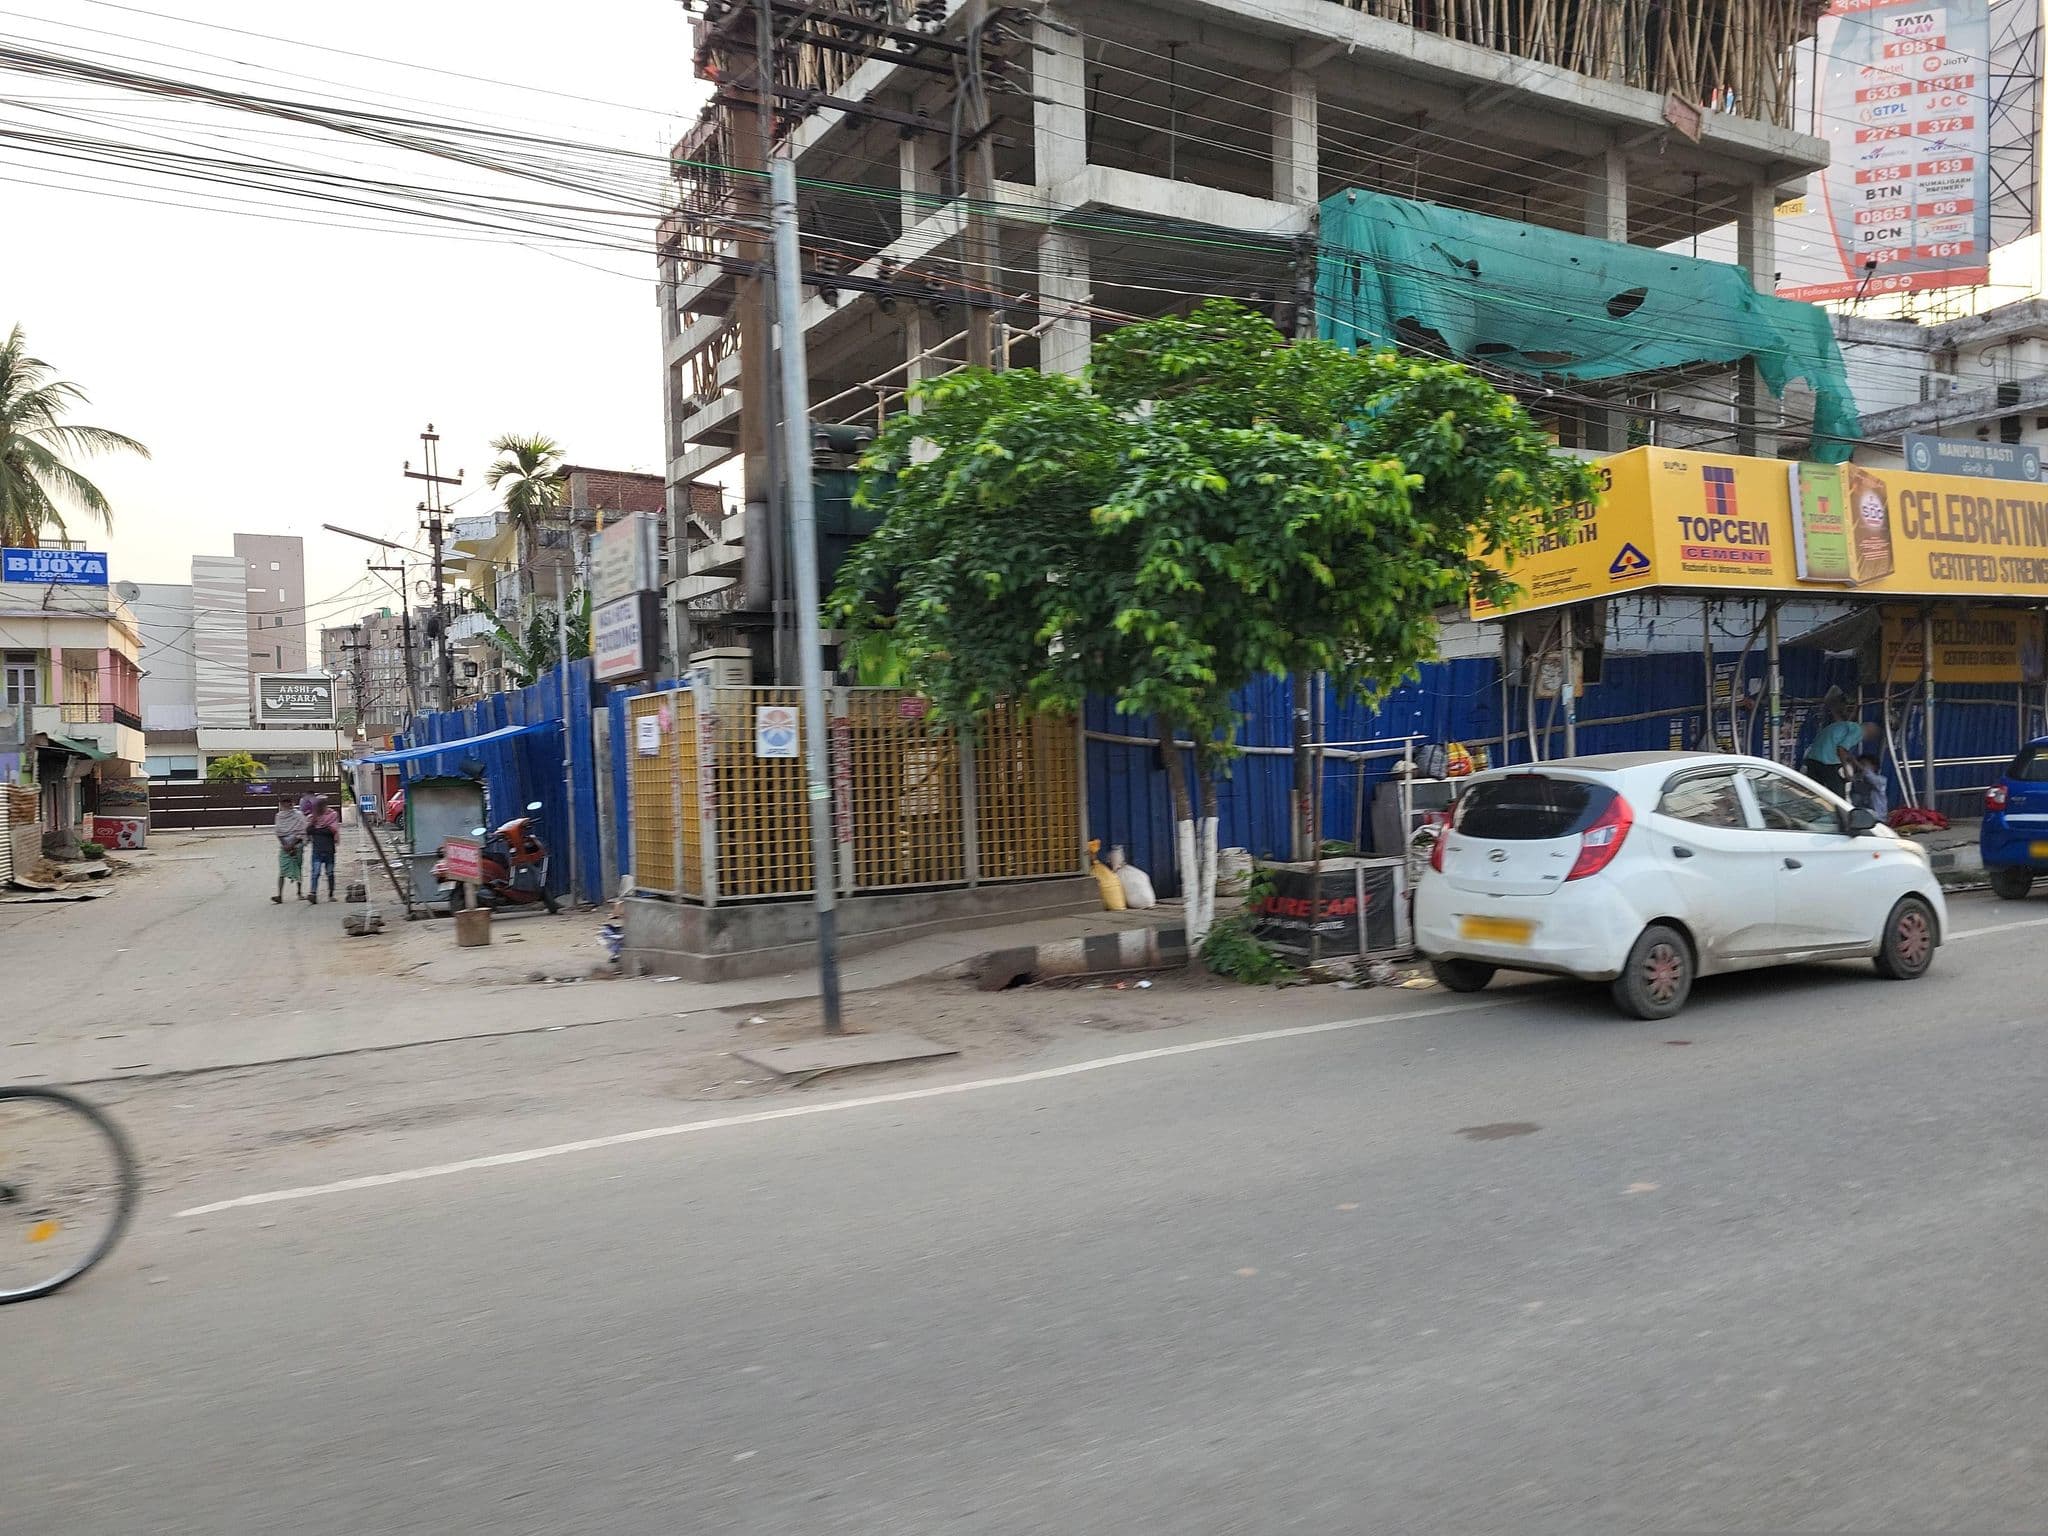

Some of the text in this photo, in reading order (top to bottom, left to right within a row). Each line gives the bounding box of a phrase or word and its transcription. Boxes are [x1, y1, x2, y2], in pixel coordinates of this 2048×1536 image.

[1894, 14, 1934, 28] TATA
[1895, 23, 1934, 37] PLAY
[1890, 38, 1939, 57] 1981
[1943, 56, 1969, 66] JioTV
[1866, 85, 1901, 101] 636
[1872, 103, 1907, 116] GTPL
[1928, 118, 1964, 134] 373
[1866, 126, 1901, 142] 273
[1928, 159, 1963, 174] 139
[1866, 167, 1901, 182] 135
[1865, 185, 1902, 200] BTN
[1860, 207, 1906, 224] 0865
[1933, 201, 1957, 215] 06
[1864, 227, 1902, 242] DCN
[1928, 243, 1961, 257] 161
[1937, 443, 2014, 462] MANIPURI BASTI
[1900, 489, 2048, 547] CELEBRATIN
[1677, 516, 1770, 546] TOPCEM
[32, 550, 80, 559] HOTEL
[1687, 548, 1766, 561] CEMENT
[7, 557, 105, 574] BIJOYA
[1929, 551, 1998, 583] CERTIFIED
[279, 685, 309, 693] AASHI
[278, 694, 318, 702] APSARA
